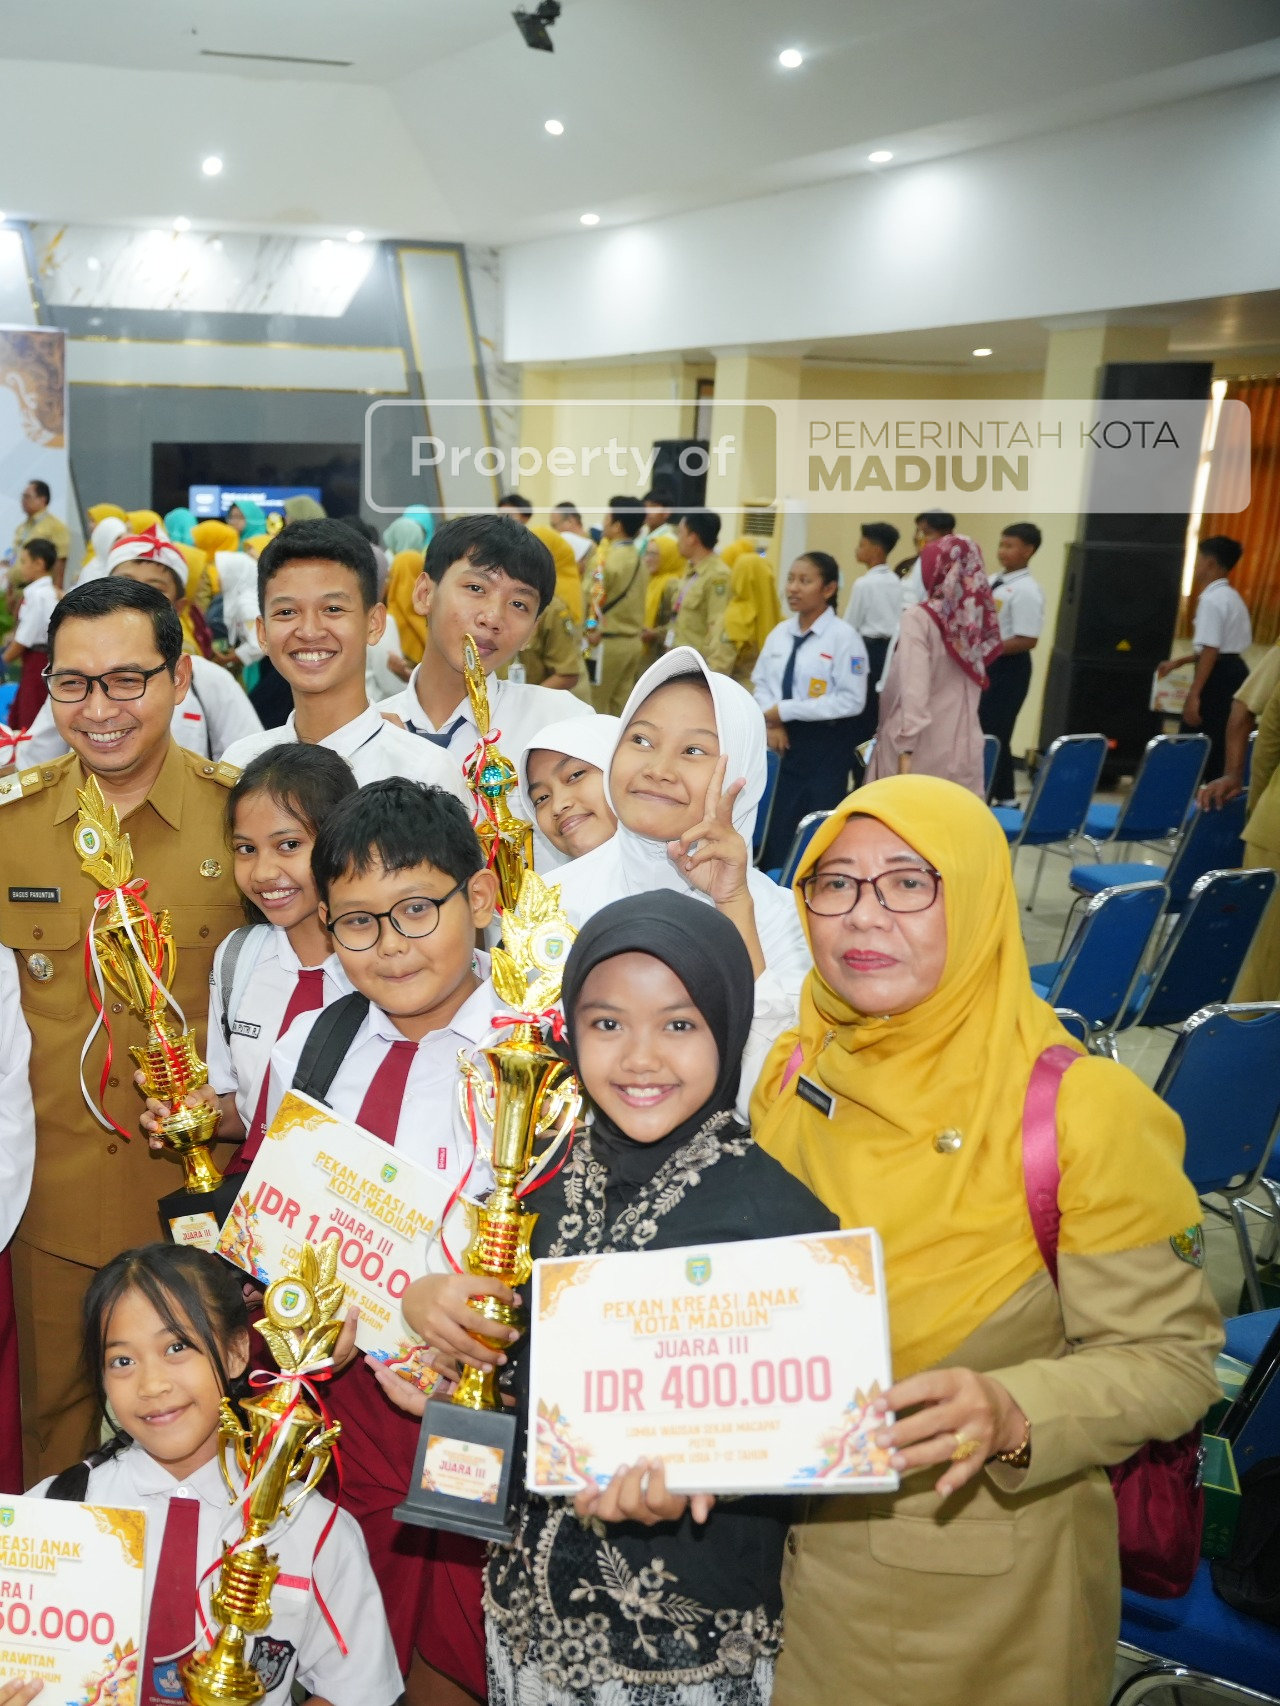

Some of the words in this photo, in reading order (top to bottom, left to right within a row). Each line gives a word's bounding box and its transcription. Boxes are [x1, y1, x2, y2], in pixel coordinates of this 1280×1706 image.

[314, 1150, 359, 1185] PEKAN
[359, 1178, 406, 1213] KREASI
[252, 1180, 301, 1230] IDR
[328, 1175, 361, 1204] KOTA
[364, 1197, 418, 1239] MADIUN
[182, 1230, 204, 1241] JUARA
[329, 1207, 375, 1245] JUARA
[376, 1236, 394, 1256] III
[360, 1294, 392, 1323] SUARA
[603, 1299, 664, 1320] PEKAN
[671, 1293, 741, 1313] KREASI
[746, 1286, 800, 1309] ANAK
[358, 1310, 385, 1332] TAHUN
[632, 1312, 681, 1335] KOTA
[688, 1307, 769, 1330] MADIUN
[653, 1338, 720, 1359] JUARA
[728, 1336, 749, 1355] III
[583, 1368, 644, 1413] IDR
[661, 1356, 833, 1409] 400.000
[439, 1460, 471, 1475] JUARA
[40, 1539, 82, 1558] ANAK
[28, 1583, 34, 1600] I
[30, 1669, 62, 1683] TAHUN
